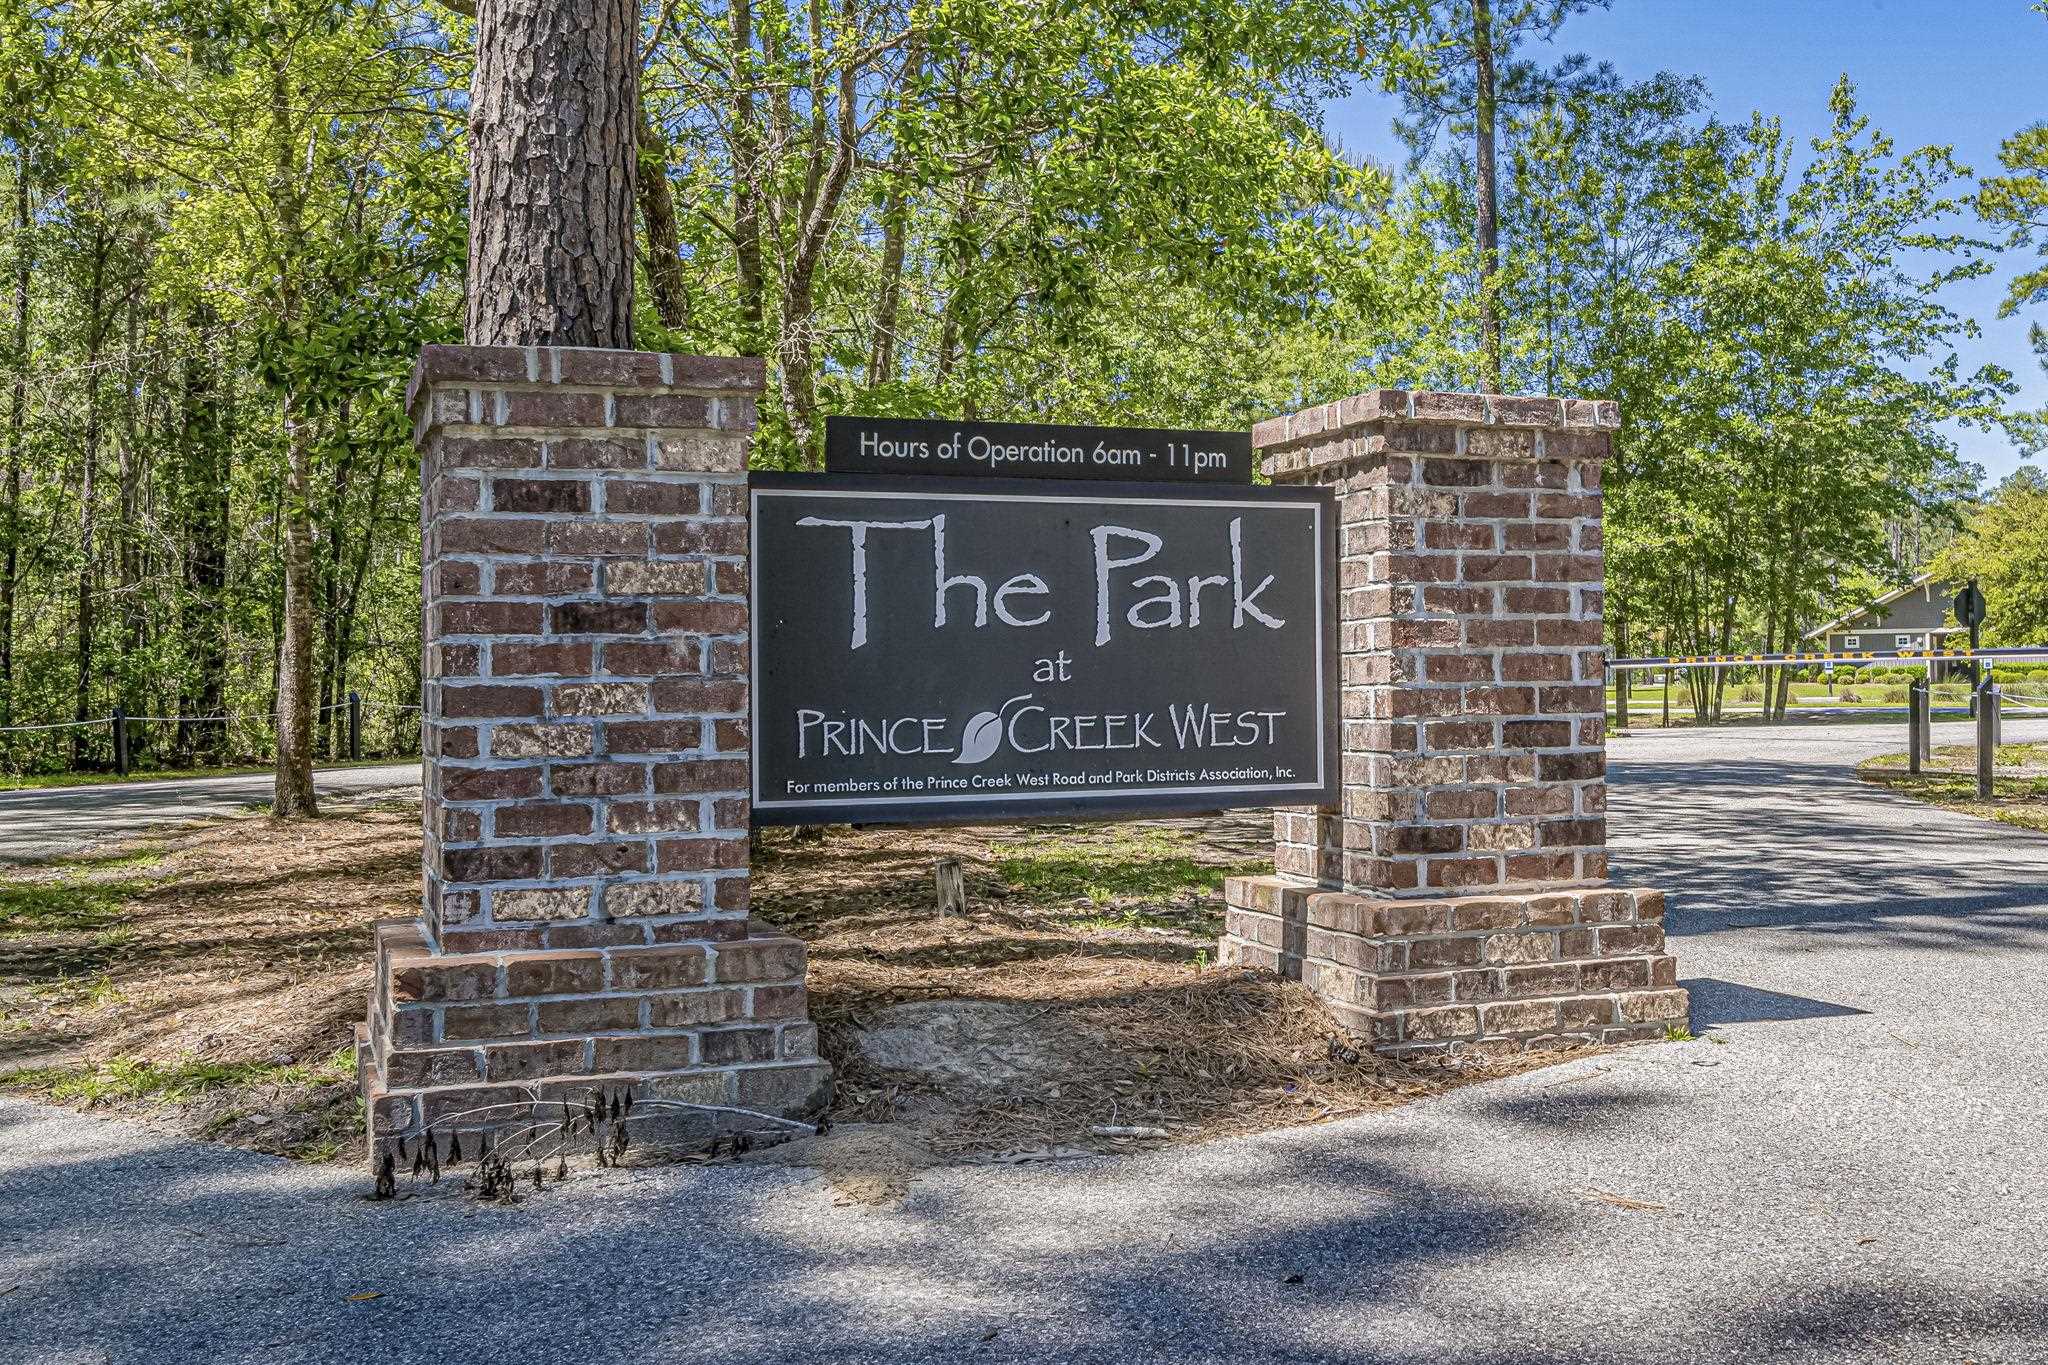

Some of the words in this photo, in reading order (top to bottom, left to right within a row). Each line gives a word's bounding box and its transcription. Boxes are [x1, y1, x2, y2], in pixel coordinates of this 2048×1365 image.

[860, 432, 930, 459] Hours
[937, 432, 962, 459] of
[967, 435, 1084, 468] Operation
[1092, 440, 1141, 465] 6am
[1167, 443, 1227, 474] 11pm
[795, 514, 1051, 650] The
[1089, 516, 1286, 647] Park
[1032, 650, 1072, 682] at
[796, 708, 955, 759] PRINCE
[1008, 705, 1161, 753] CREEK
[1169, 702, 1287, 749] WEST
[786, 780, 810, 794] For
[814, 778, 880, 793] members
[883, 777, 899, 790] of
[901, 776, 924, 790] the
[927, 776, 968, 789] Prince
[972, 774, 1012, 788] Creek
[1016, 773, 1049, 786] West
[1053, 772, 1086, 785] Road
[1089, 772, 1112, 784] and
[1116, 770, 1144, 783] Park
[1147, 769, 1195, 782] Districts
[1200, 766, 1273, 780] Association,
[1276, 766, 1296, 779] Inc.
